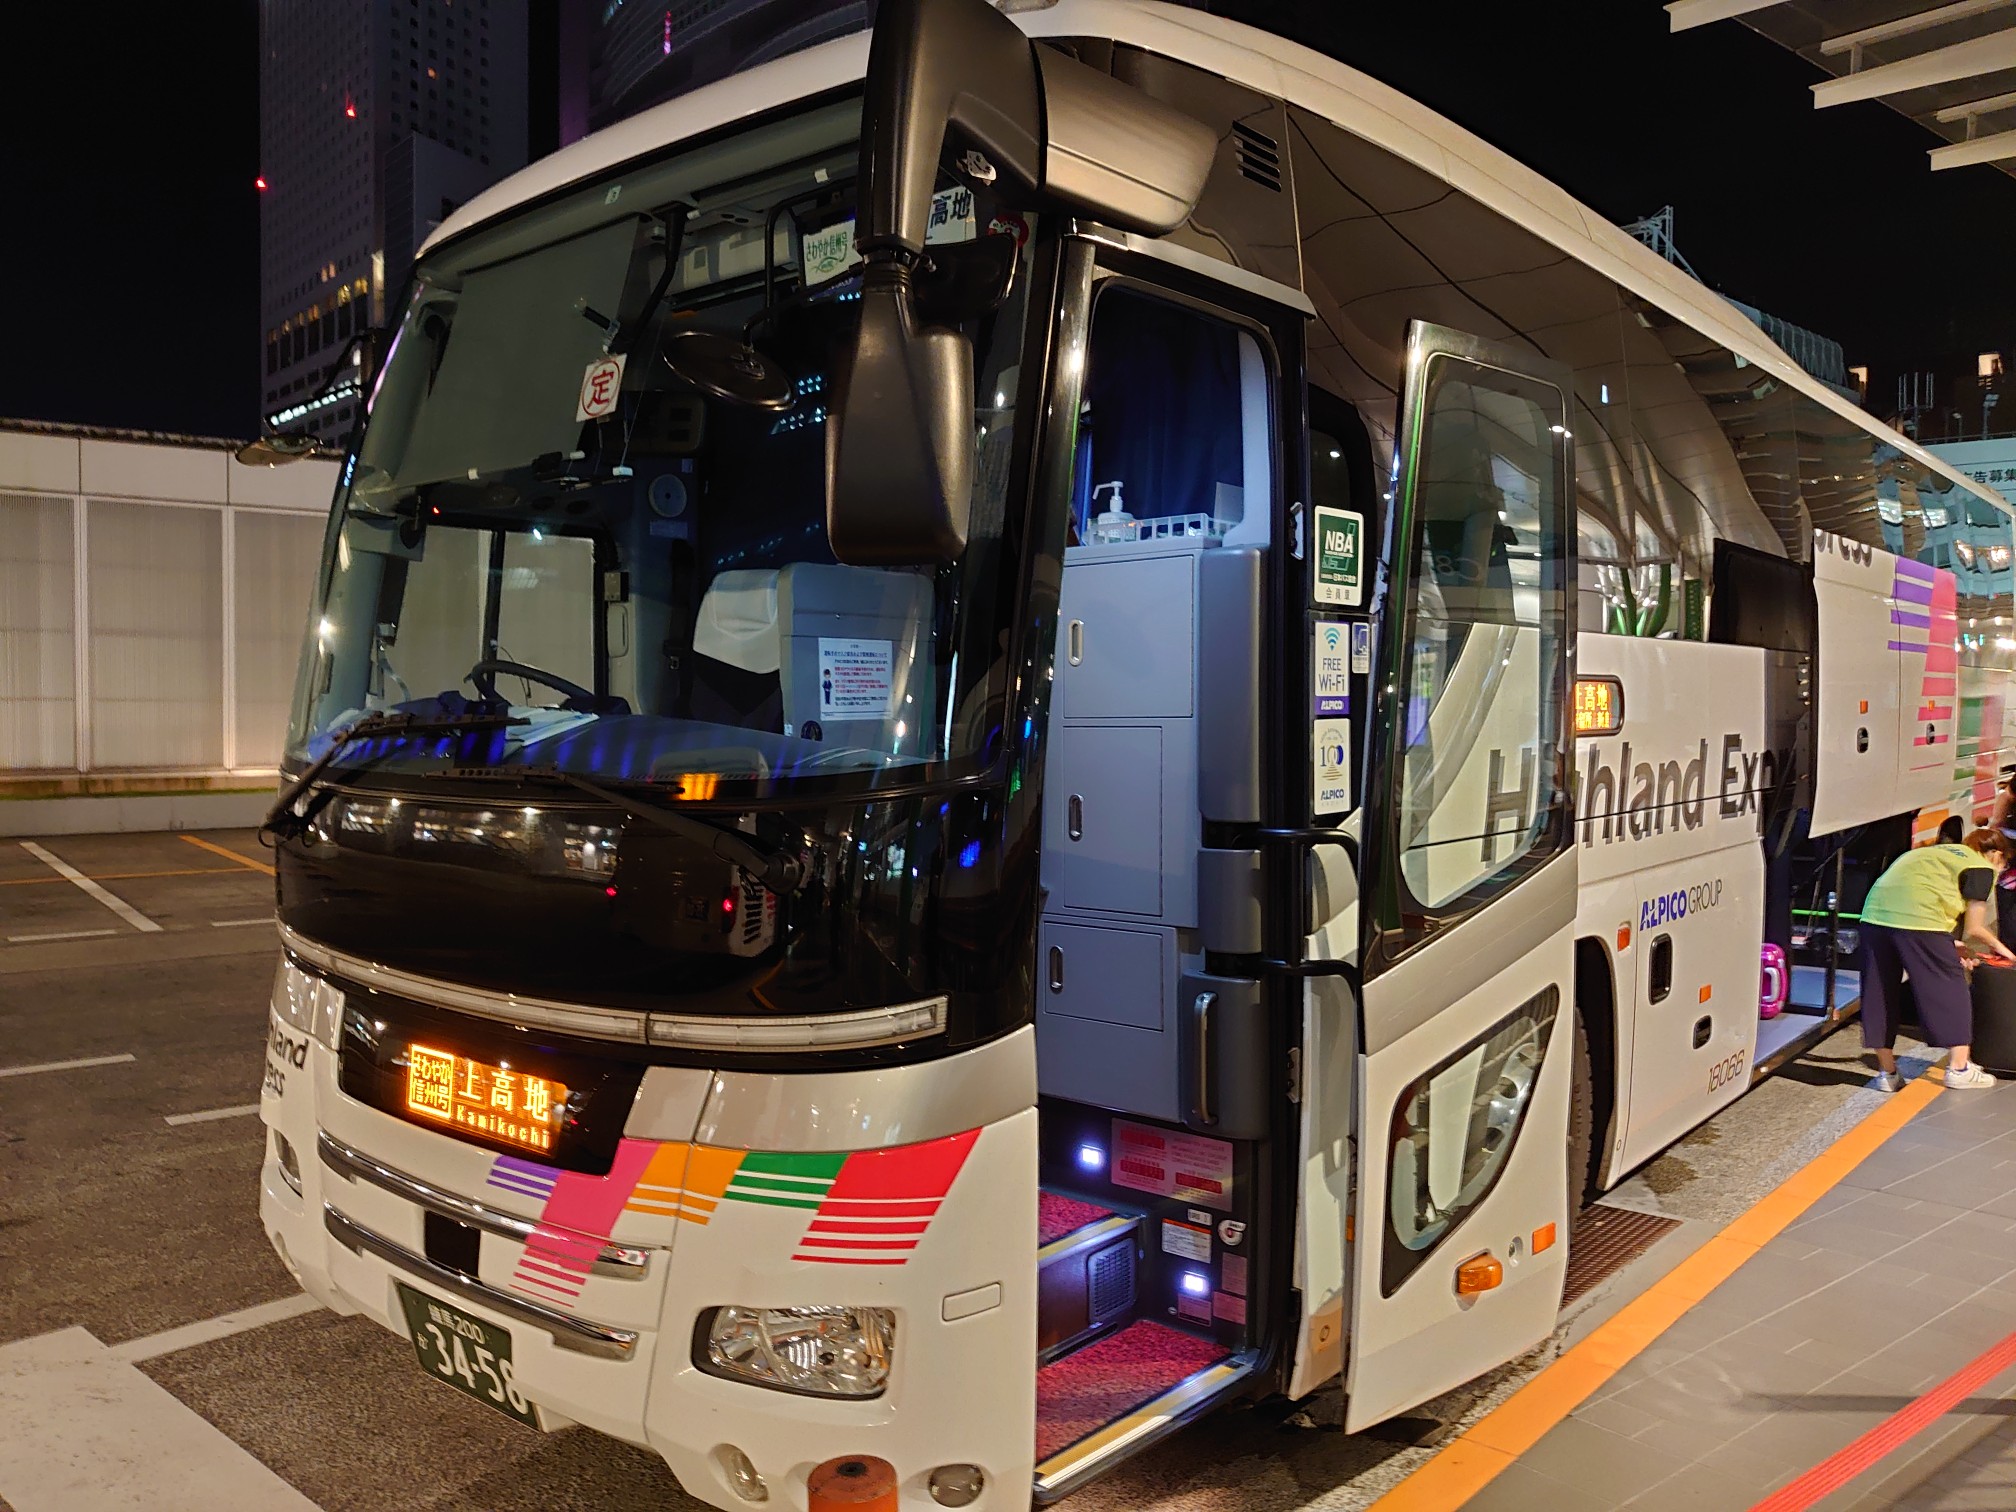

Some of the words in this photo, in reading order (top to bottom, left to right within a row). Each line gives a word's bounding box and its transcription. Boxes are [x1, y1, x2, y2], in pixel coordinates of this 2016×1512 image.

[926, 188, 972, 239] 高地
[587, 369, 615, 409] 定
[1964, 468, 2016, 484] 告募集
[1324, 529, 1354, 554] NBA
[1322, 657, 1342, 671] FREE
[1318, 673, 1345, 692] Wi-Fi
[1320, 788, 1345, 801] ALPICO
[1481, 738, 1708, 867] Hhland
[1639, 889, 1687, 932] ALPICO
[1688, 878, 1723, 915] GROUP
[412, 1054, 451, 1085] さわやか
[1707, 1049, 1745, 1096] 18066
[411, 1078, 450, 1110] 信州号
[457, 1061, 550, 1122] 上高地
[456, 1104, 550, 1149] Kamikochi
[454, 1314, 486, 1345] 200
[424, 1321, 529, 1415] 34-58
